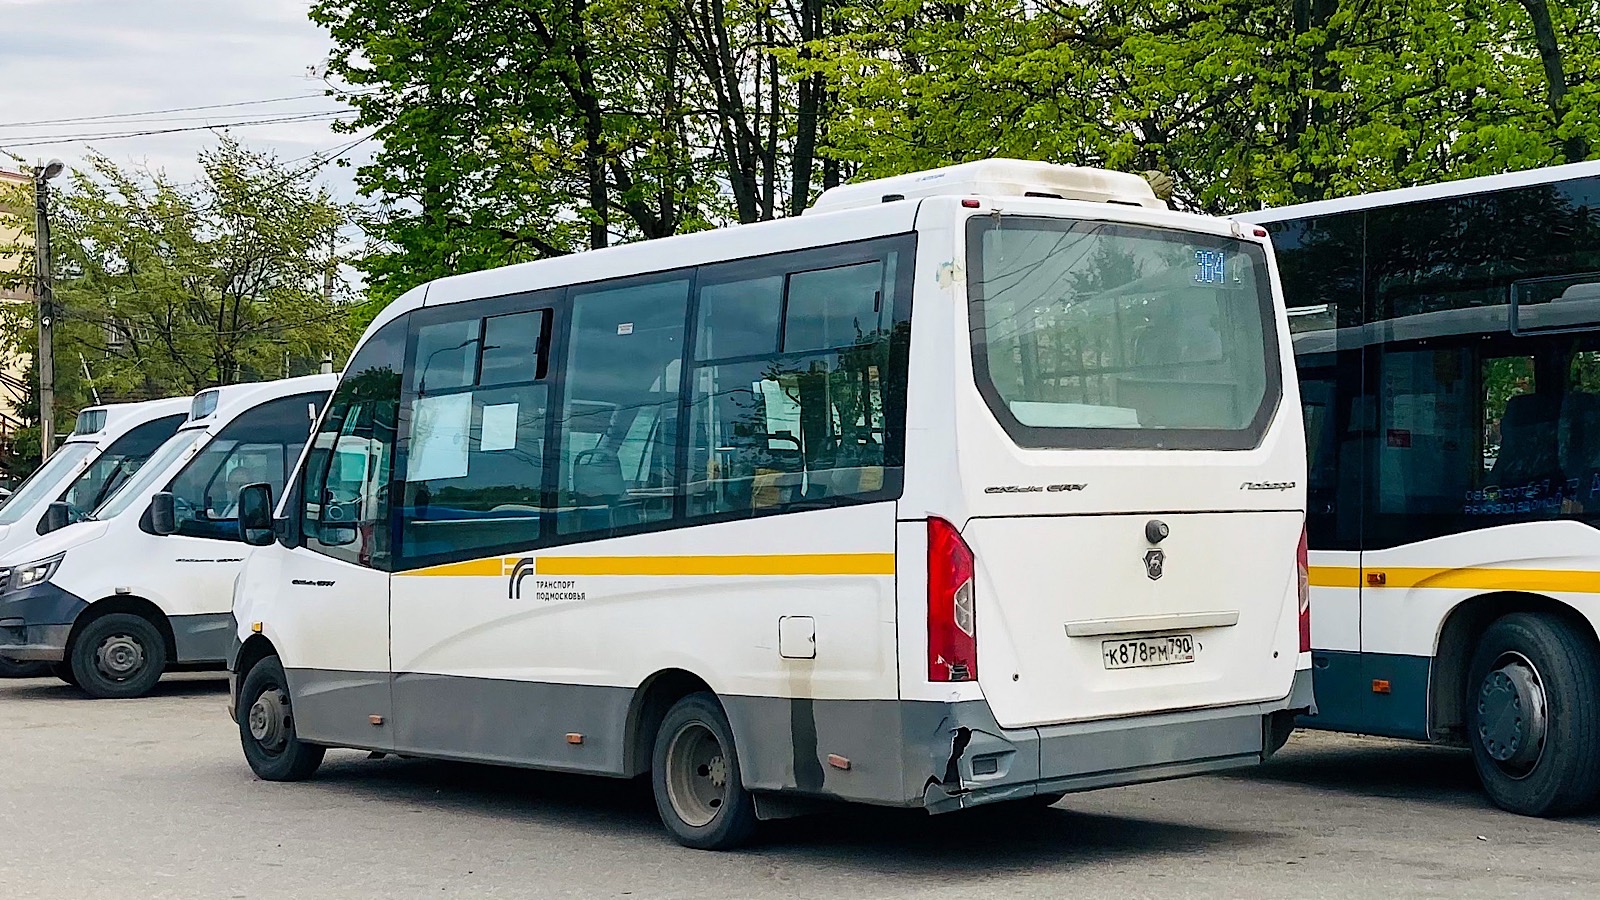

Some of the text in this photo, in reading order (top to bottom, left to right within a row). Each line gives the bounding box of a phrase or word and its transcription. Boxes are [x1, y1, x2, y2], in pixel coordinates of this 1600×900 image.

[1194, 250, 1224, 284] 364
[536, 580, 576, 589] ТРАНСПОРТ
[536, 592, 586, 602] ПОДМОСКОВЬЯ
